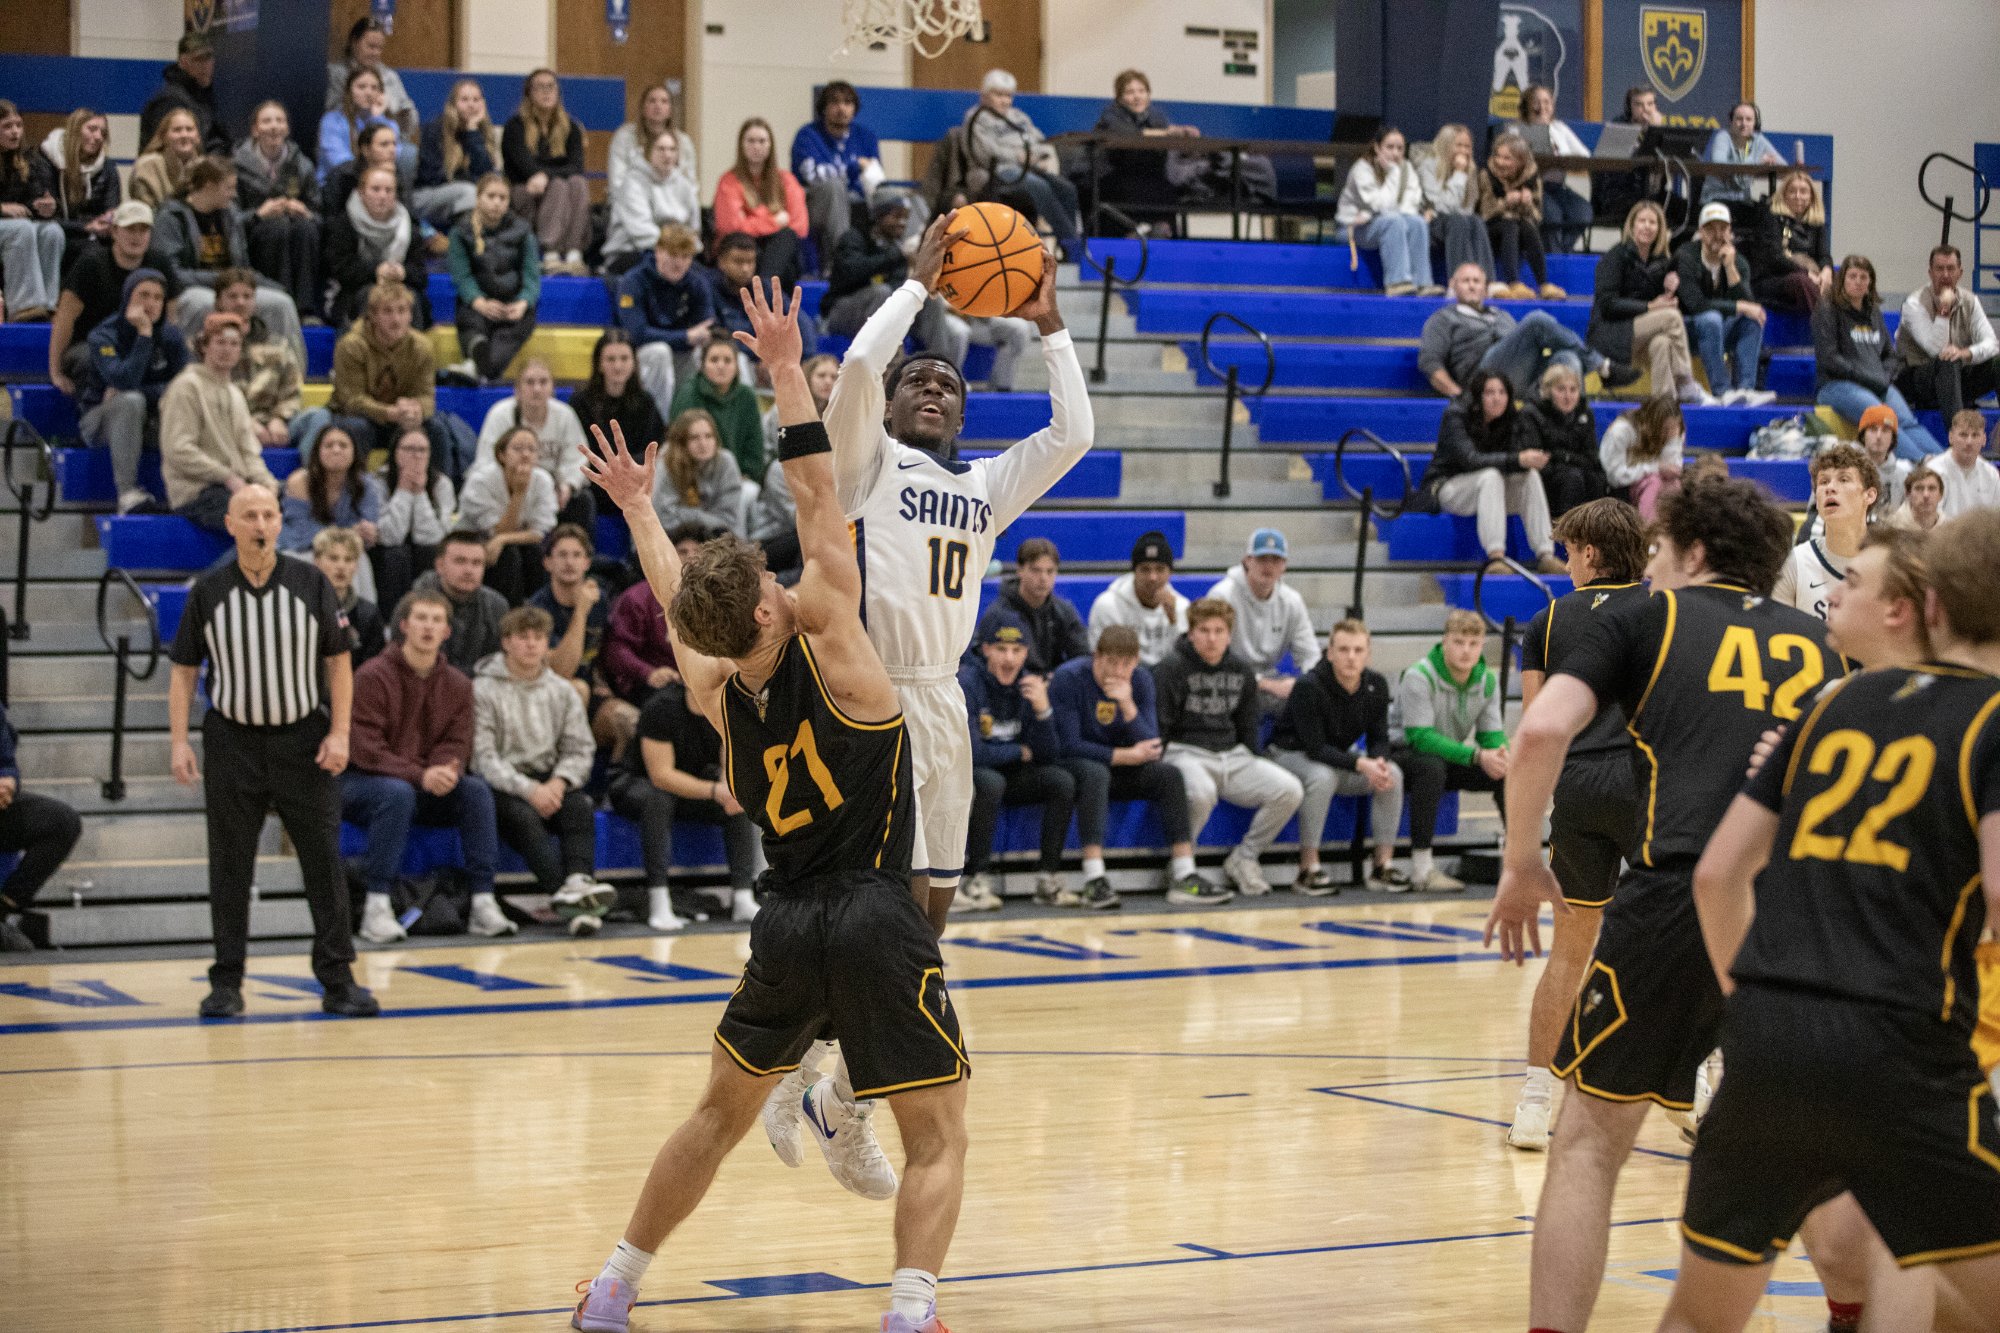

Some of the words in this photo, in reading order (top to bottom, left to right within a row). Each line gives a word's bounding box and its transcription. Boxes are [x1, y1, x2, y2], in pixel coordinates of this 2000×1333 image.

[899, 486, 992, 534] SAINTS
[927, 536, 970, 601] 10
[1707, 624, 1825, 722] 42
[763, 718, 844, 837] 21
[1788, 728, 1937, 873] 22
